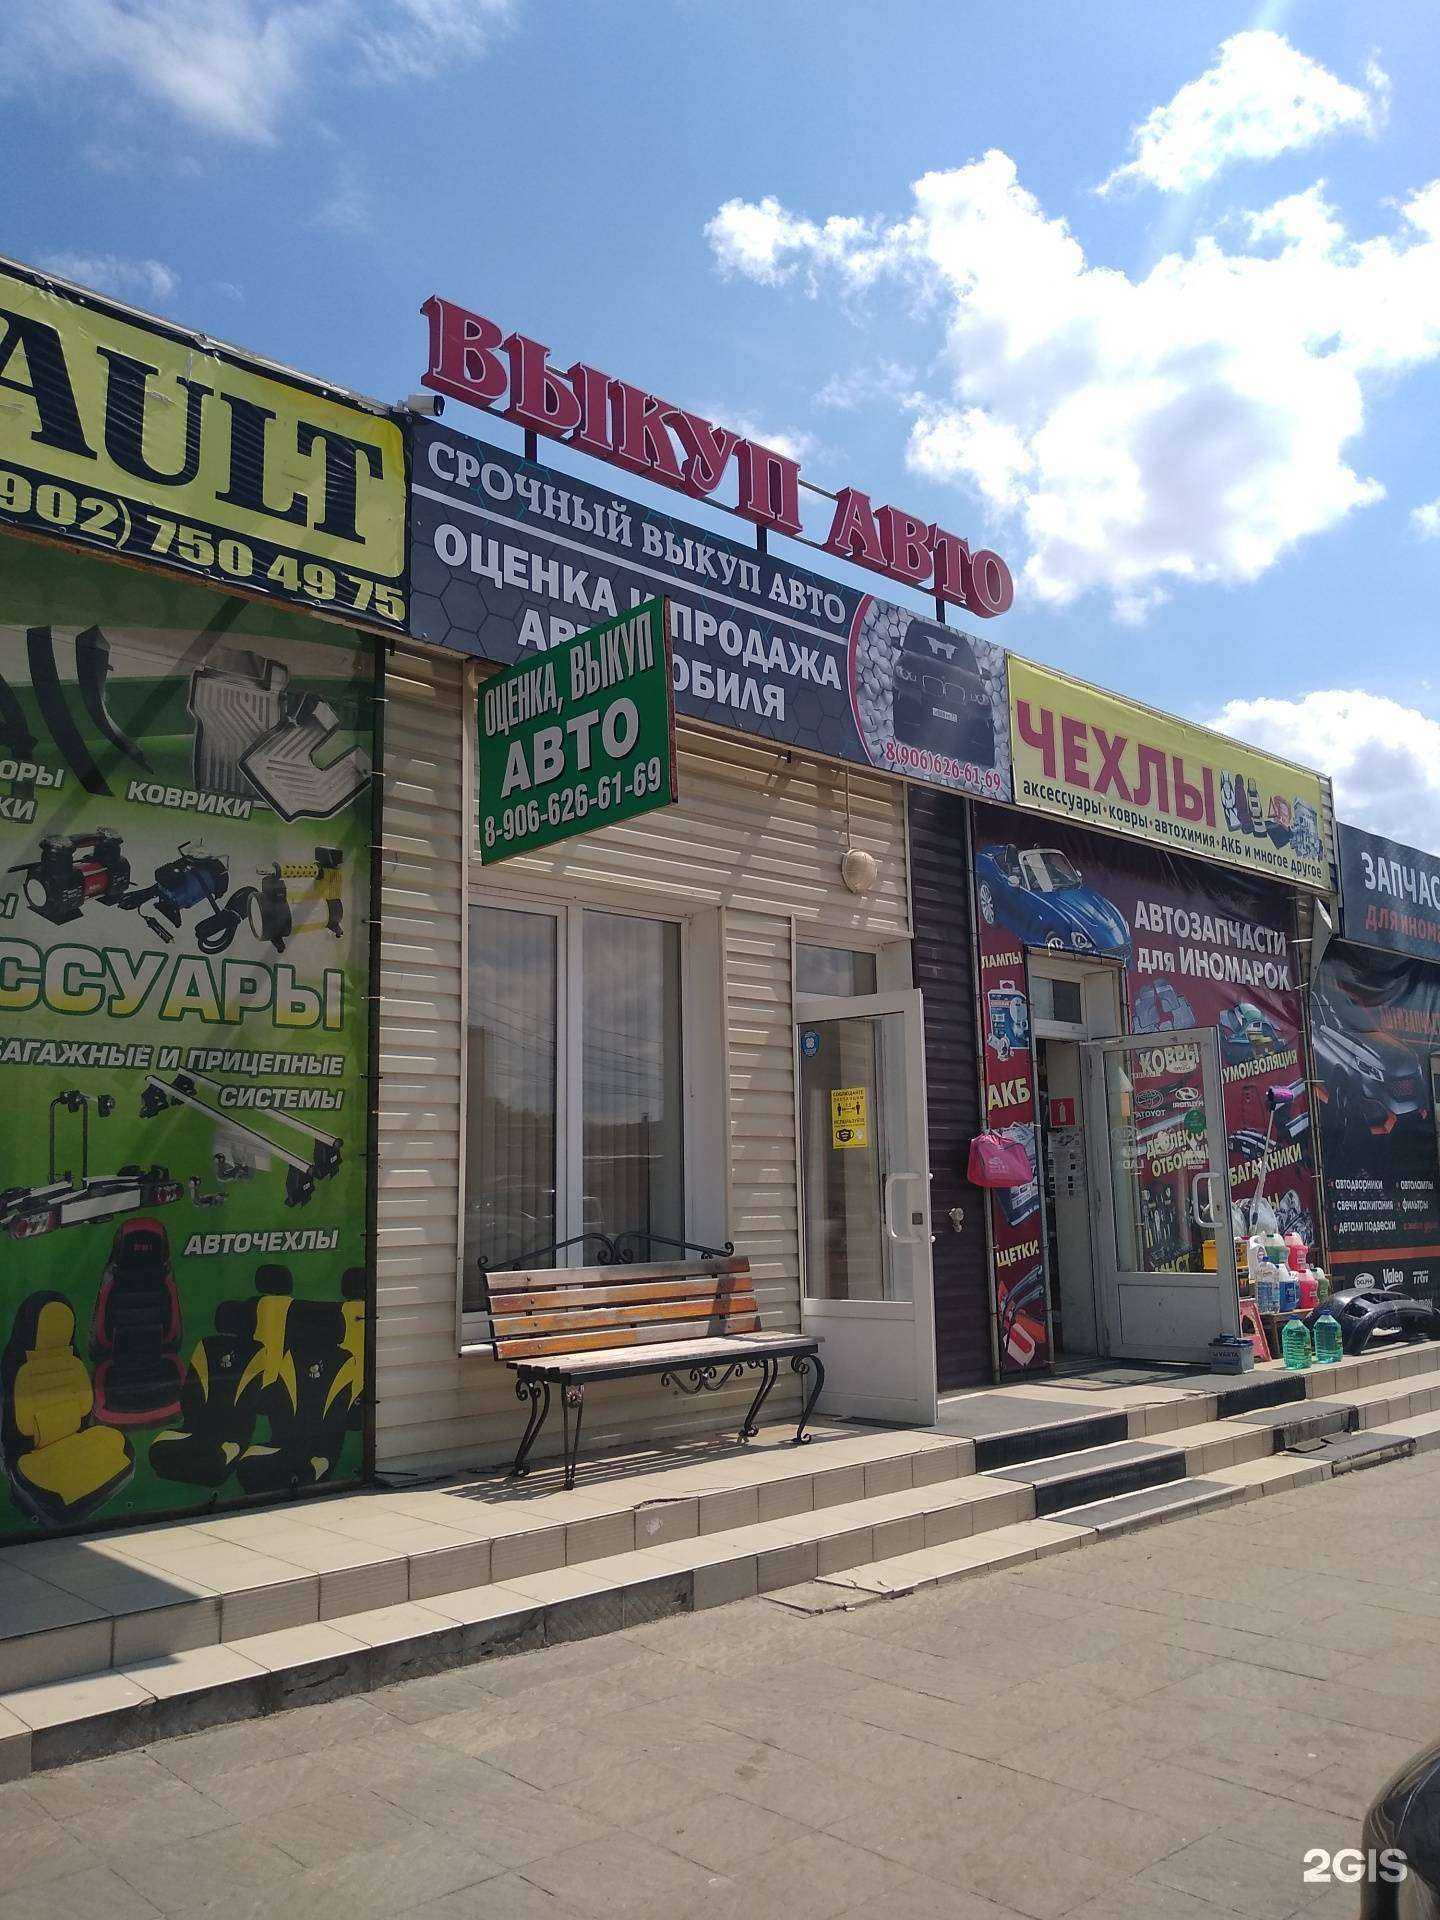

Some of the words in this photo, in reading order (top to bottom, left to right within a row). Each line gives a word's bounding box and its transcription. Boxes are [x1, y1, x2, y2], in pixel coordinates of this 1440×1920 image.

[420, 295, 803, 538] ВЫКУП
[822, 487, 1014, 619] АВТО
[427, 441, 634, 550] СРОЧНЫЙ
[641, 521, 761, 596] ВЫКУП
[768, 574, 847, 625] АВТО
[146, 514, 254, 577] 750
[267, 553, 337, 601] 49
[342, 574, 405, 621] 75
[433, 524, 618, 617] ОЦЕНКА
[669, 600, 842, 700] ПРОДАЖА
[485, 661, 564, 737] ОЦЕНКА,
[570, 611, 655, 700] ВЫКУП
[500, 698, 639, 799] АВТО
[886, 742, 1001, 790] 8(906)626-61-69
[1016, 700, 1217, 828] ЧЕХЛЫ
[128, 781, 251, 819] КОВРИКИ
[484, 756, 662, 847] 8-906-626-61-69
[1023, 780, 1101, 814] аксессуары
[1108, 805, 1148, 829] ковры
[1154, 821, 1216, 848] автохимия
[1221, 836, 1242, 855] АКБ
[1253, 849, 1289, 868] многое
[1291, 859, 1323, 880] другое
[1135, 901, 1287, 956] АВТОЗАПЧАСТИ
[1365, 905, 1398, 931] ДЛЯ
[981, 952, 1022, 969] ЛАМПЫ
[1179, 947, 1291, 991] ИНОМАРОК
[0, 1040, 151, 1067] АГАЖНЫЕ
[160, 1048, 181, 1066] И
[188, 1049, 344, 1075] ПРИЦЕПНЫЕ
[220, 1087, 343, 1109] СИСТЕМЫ
[988, 1078, 1031, 1110] АКБ
[184, 1229, 339, 1256] АВТОЧЕХЛЫ
[997, 1240, 1040, 1267] ЩЕТКИ
